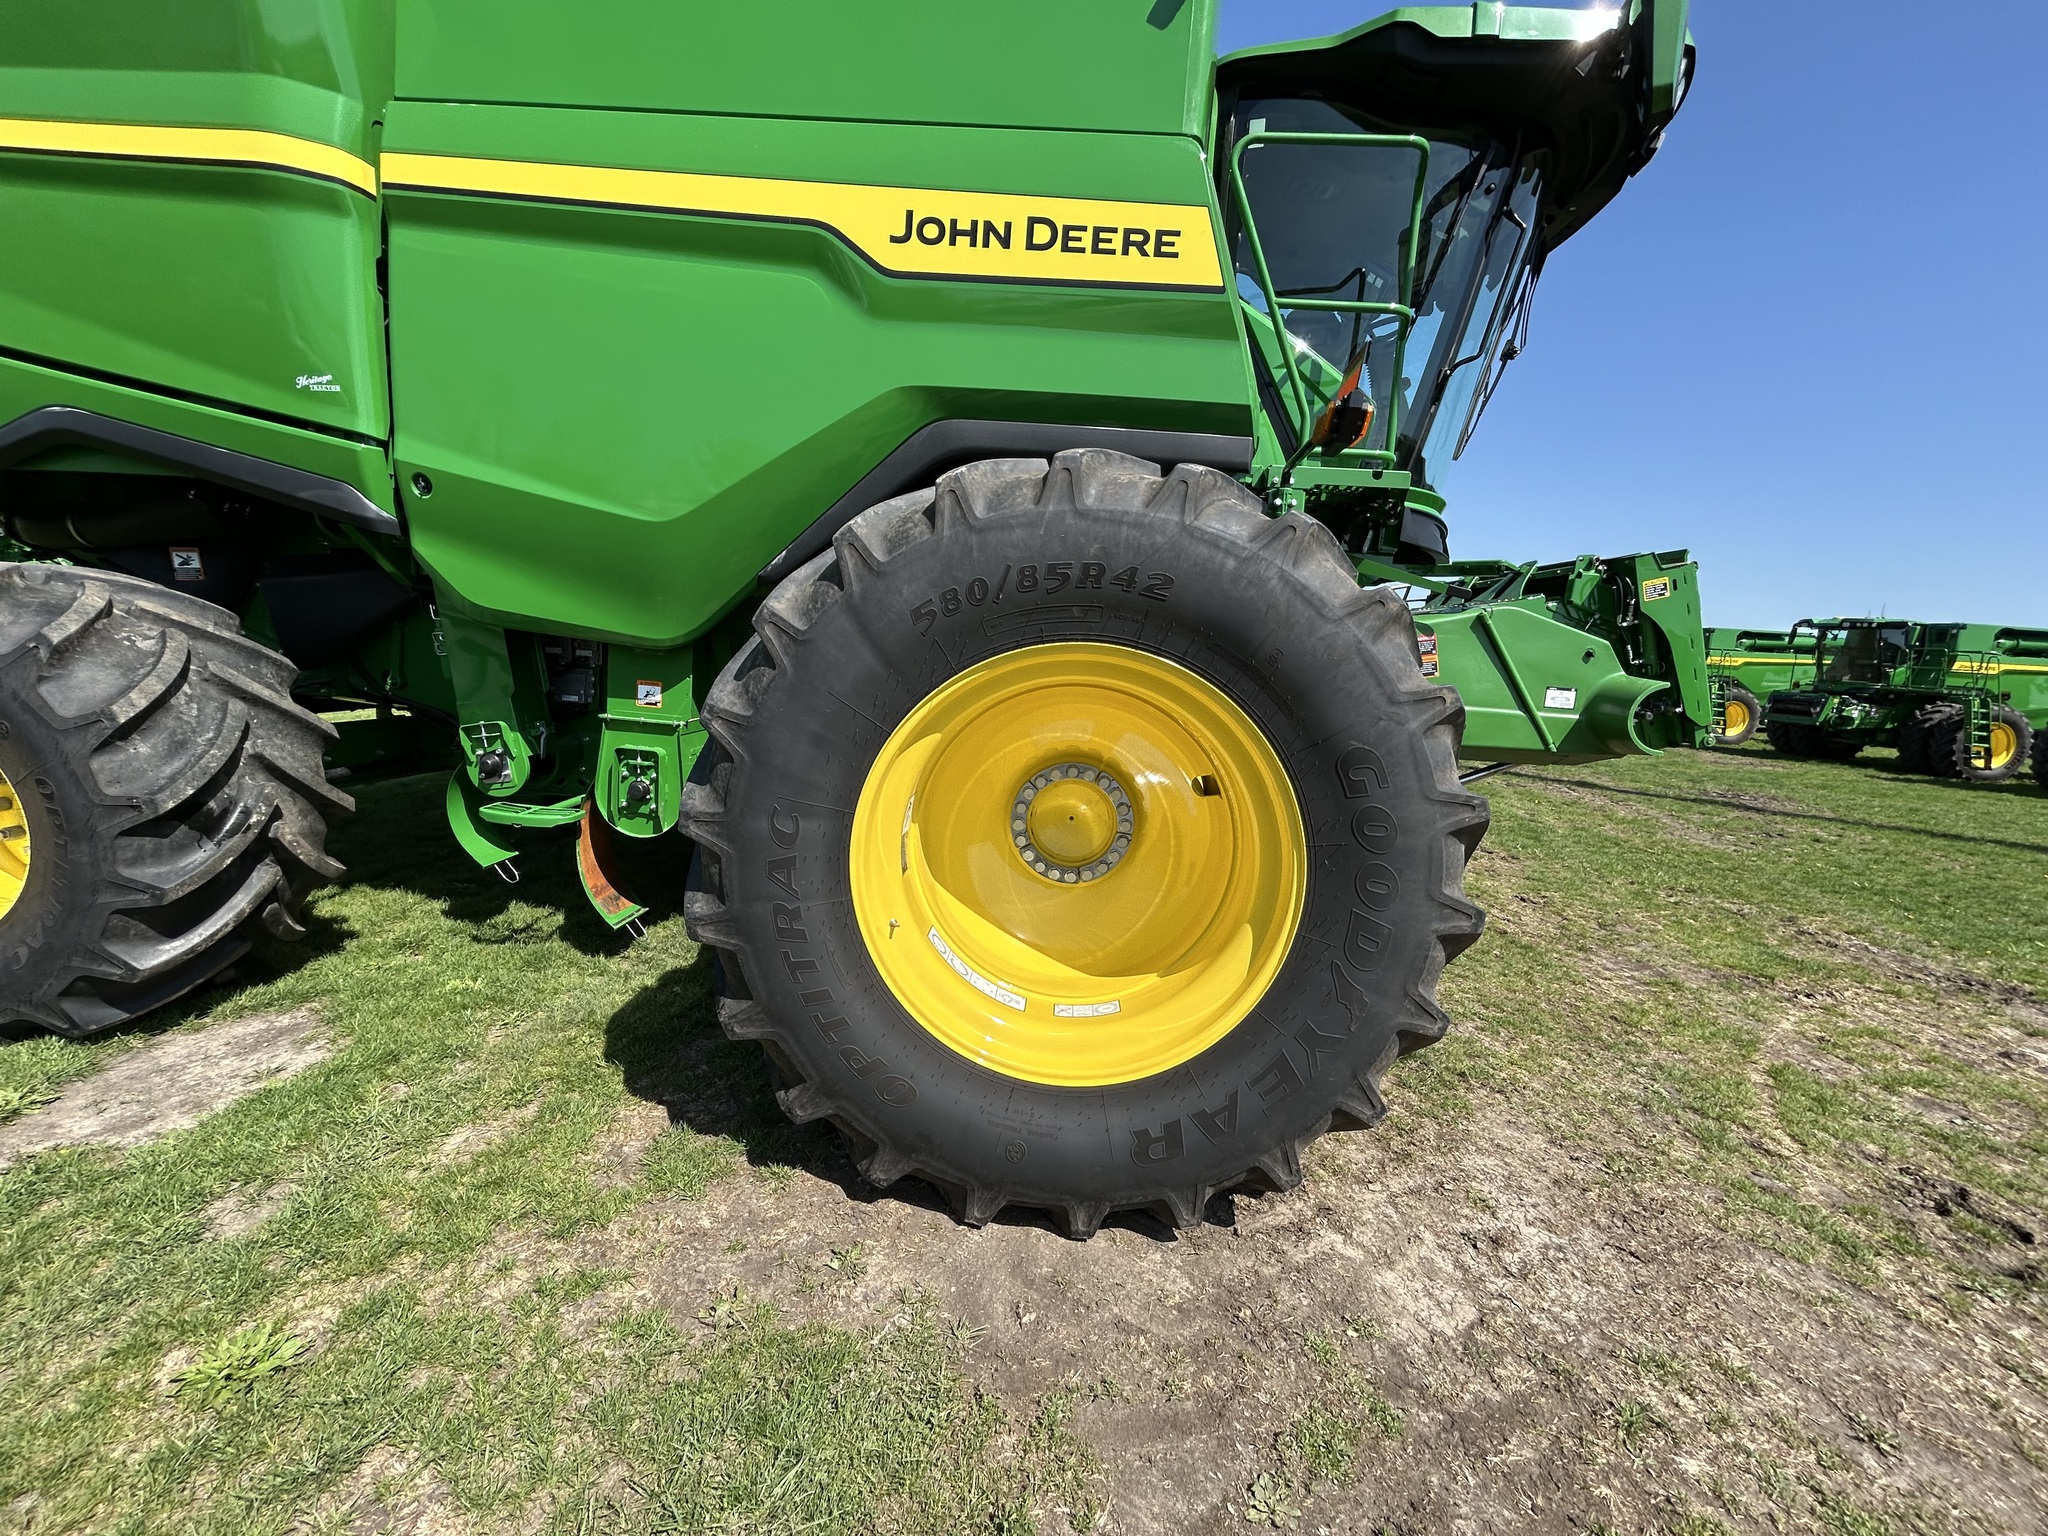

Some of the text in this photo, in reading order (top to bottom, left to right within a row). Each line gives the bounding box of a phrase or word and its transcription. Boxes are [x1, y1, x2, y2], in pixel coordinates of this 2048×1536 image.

[889, 209, 1182, 259] JOHN DEERE
[296, 374, 333, 389] Heritage
[908, 560, 1176, 638] 580/85R42
[765, 803, 919, 1108] OPTITRAC
